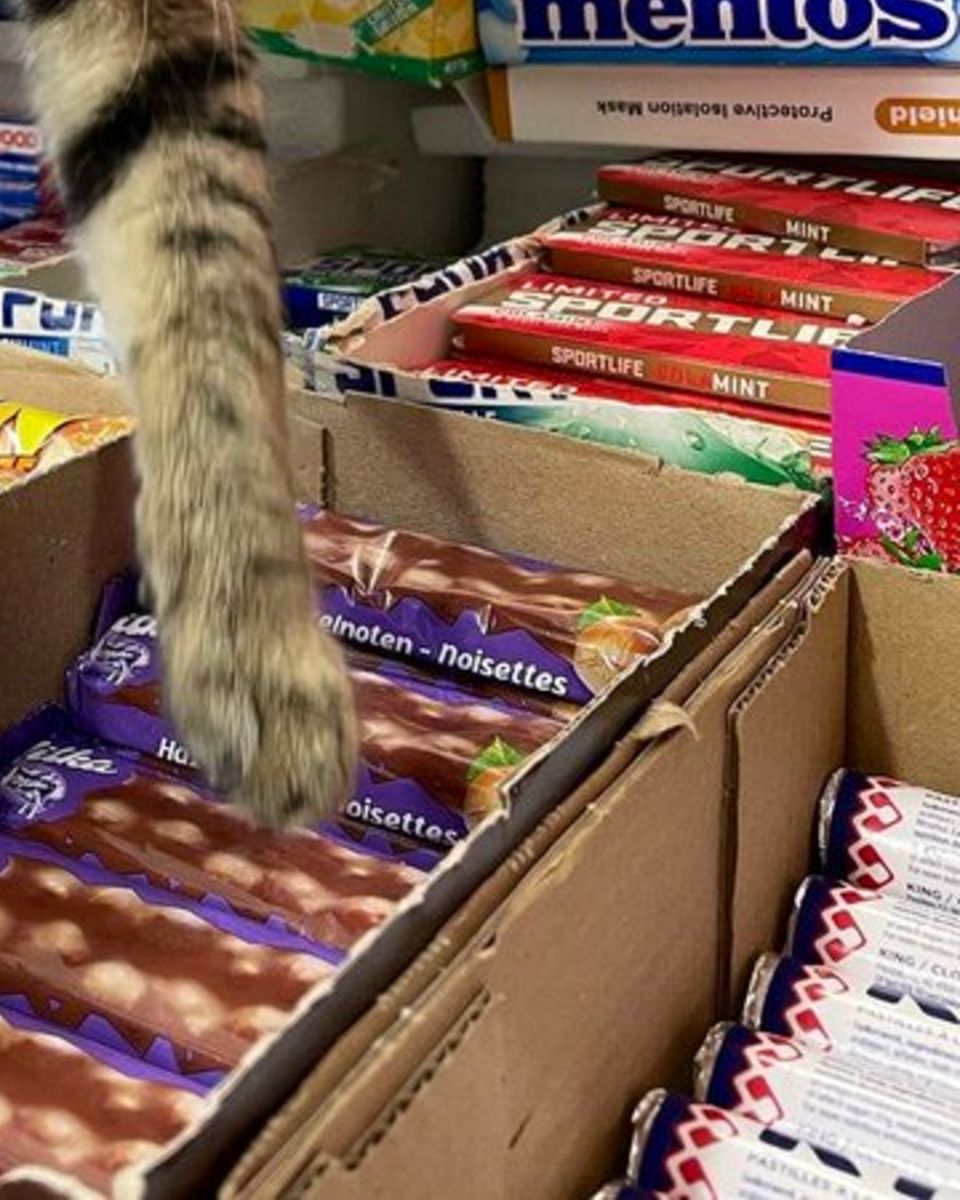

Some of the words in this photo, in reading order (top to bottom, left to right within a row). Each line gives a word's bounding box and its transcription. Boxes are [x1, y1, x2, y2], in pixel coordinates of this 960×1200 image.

[596, 100, 644, 118] Mask
[647, 101, 729, 120] Isolation
[733, 102, 833, 123] Protective
[890, 104, 960, 127] hield
[662, 194, 735, 223] SPORTLIFE
[785, 219, 831, 243] MINT
[522, 280, 669, 306] LIMITED
[631, 267, 719, 296] SPORTLIFE
[779, 288, 834, 314] MINT
[501, 289, 864, 349] SPORTLIF
[550, 345, 645, 378] SPORTLIFE
[711, 372, 770, 400] MINT
[24, 740, 119, 775] ilka
[344, 798, 459, 845] oisettes
[906, 882, 942, 900] KING
[879, 947, 916, 968] KING
